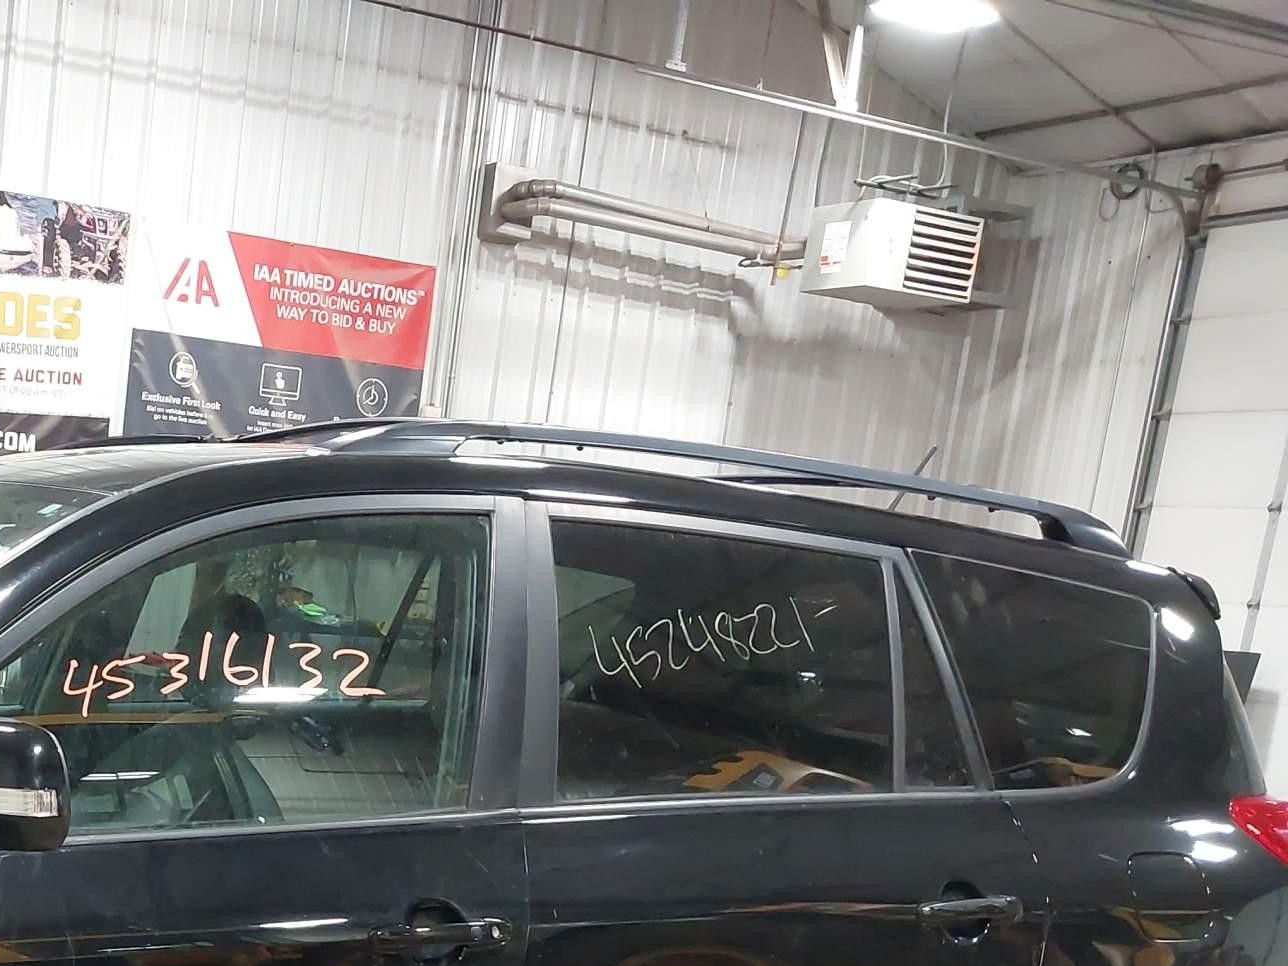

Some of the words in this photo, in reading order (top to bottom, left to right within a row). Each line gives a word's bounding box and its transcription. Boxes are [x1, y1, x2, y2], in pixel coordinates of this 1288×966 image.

[253, 263, 281, 284] IAA
[283, 269, 335, 292] TIMED
[269, 286, 361, 314] INTRODUCING
[362, 302, 374, 316] A
[375, 304, 407, 321] NEW
[276, 303, 309, 321] WAY
[310, 308, 329, 325] TO
[332, 313, 353, 329] BID
[355, 317, 366, 331] &
[368, 319, 397, 335] BUY
[44, 344, 80, 359] AUCTION
[13, 368, 83, 386] AUCTION
[141, 391, 181, 405] Exclusive
[182, 396, 200, 408] First
[201, 399, 222, 411] Look
[248, 405, 270, 417] Quick
[271, 409, 287, 419] and
[287, 410, 307, 423] Easy
[63, 631, 386, 718] 45316132
